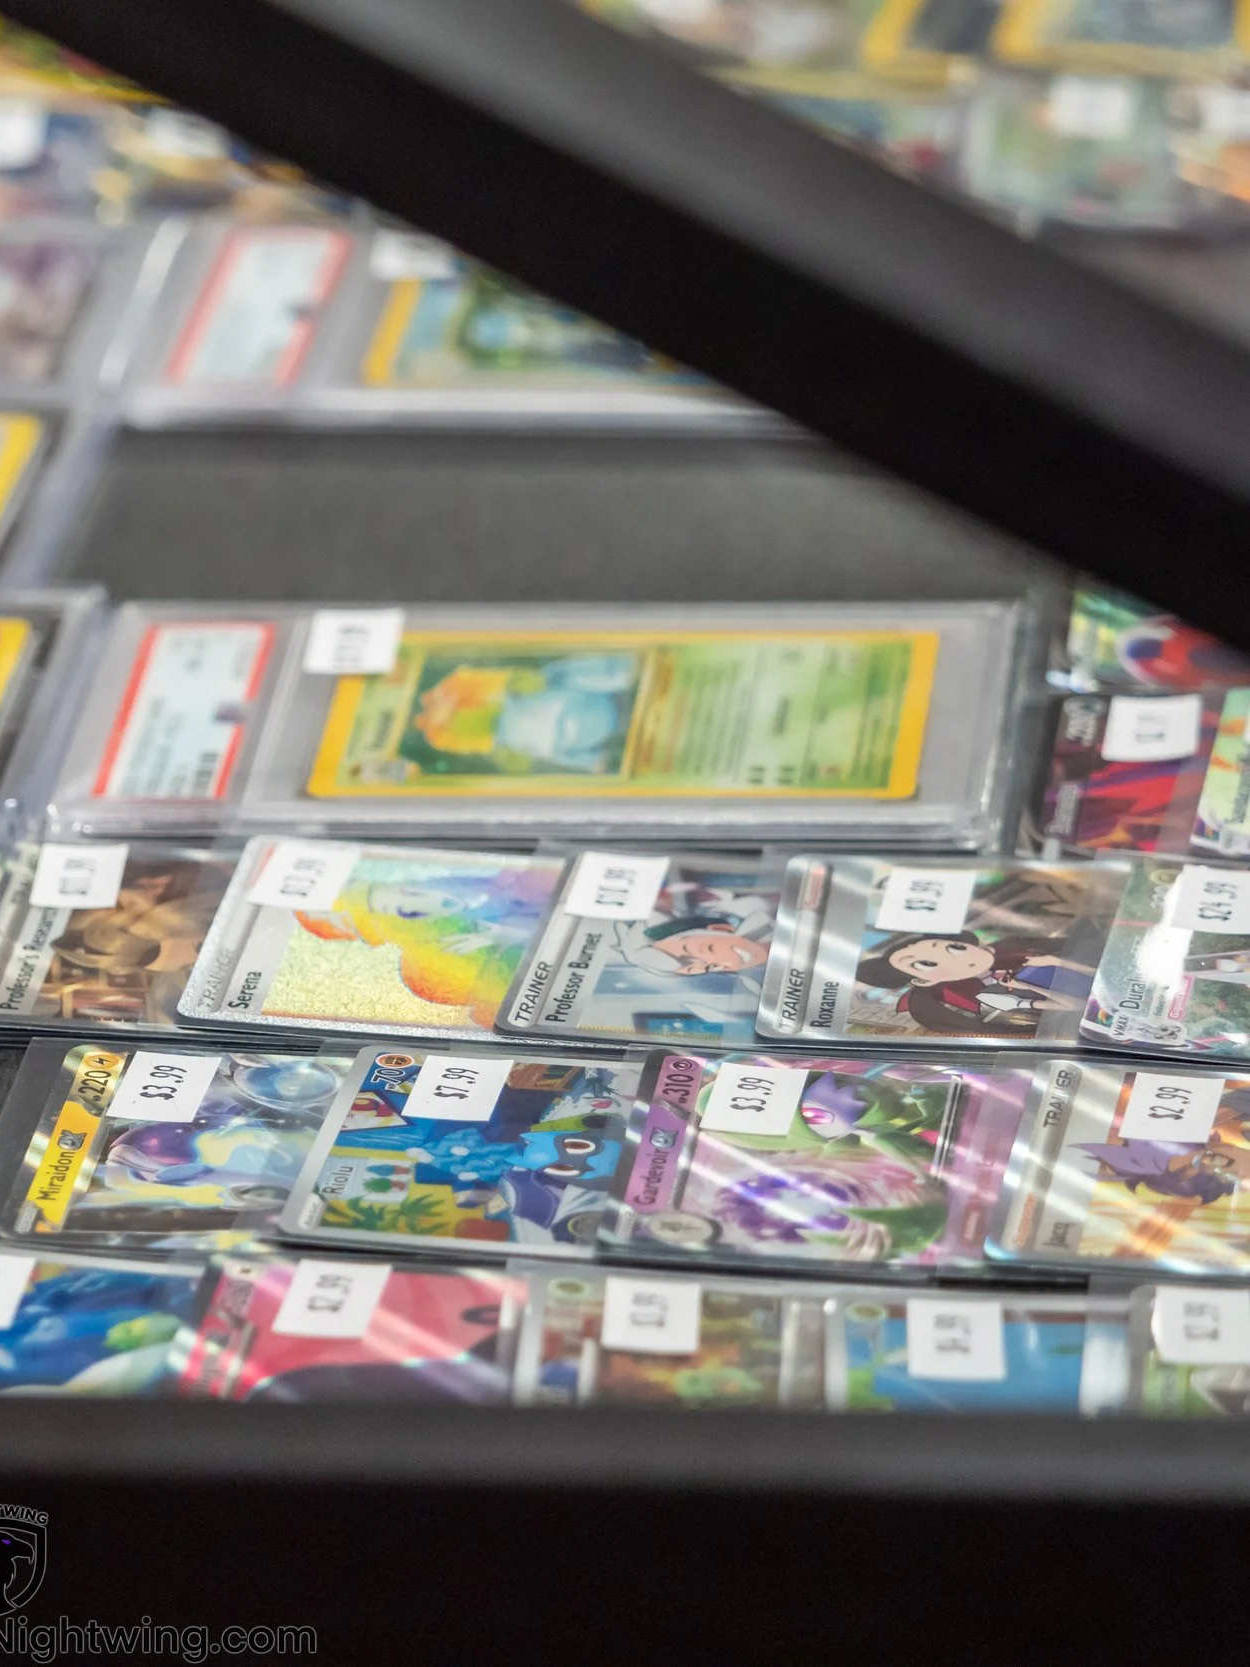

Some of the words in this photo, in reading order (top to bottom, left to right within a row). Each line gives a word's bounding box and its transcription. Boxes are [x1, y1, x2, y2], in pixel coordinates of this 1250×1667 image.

[1197, 880, 1238, 922] $24.99
[228, 970, 263, 1010] Serena
[514, 960, 554, 1023] TRAINER
[544, 970, 584, 1024] Professor
[568, 932, 603, 970] Burnet
[779, 967, 806, 1030] TRAINER
[810, 980, 840, 1029] Roxanne
[1113, 1015, 1130, 1037] VMAX
[138, 1064, 188, 1101] $3.99
[433, 1066, 480, 1100] $7.99
[729, 1076, 775, 1113] $3.99
[1147, 1085, 1194, 1121] $2.99
[35, 1150, 76, 1201] Miraidon
[321, 1164, 354, 1196] Riolu
[633, 1149, 670, 1206] Gardevoir
[306, 1273, 354, 1313] $2.99
